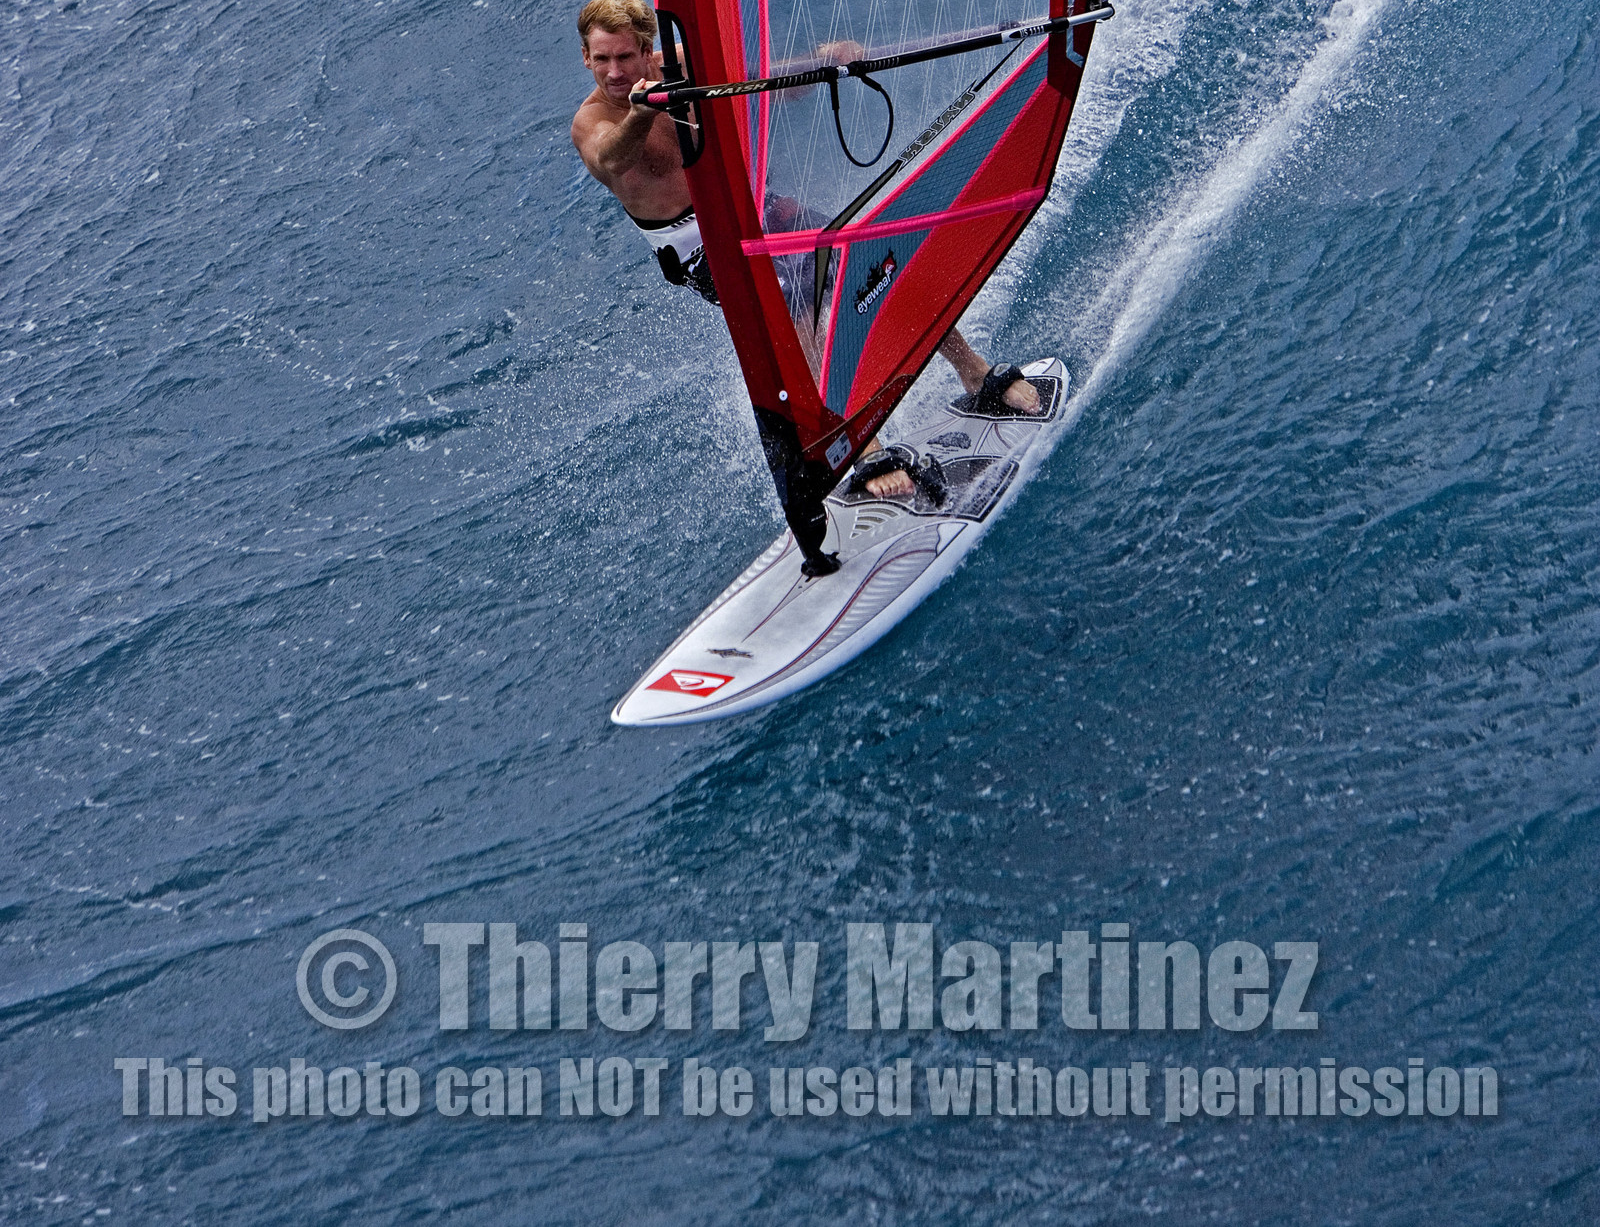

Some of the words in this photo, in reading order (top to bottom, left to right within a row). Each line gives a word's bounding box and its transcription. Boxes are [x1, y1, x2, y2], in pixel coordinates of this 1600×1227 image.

[705, 81, 769, 97] NAISH
[857, 271, 892, 314] eyewear
[856, 406, 884, 442] FORCE
[832, 443, 848, 465] 4.7
